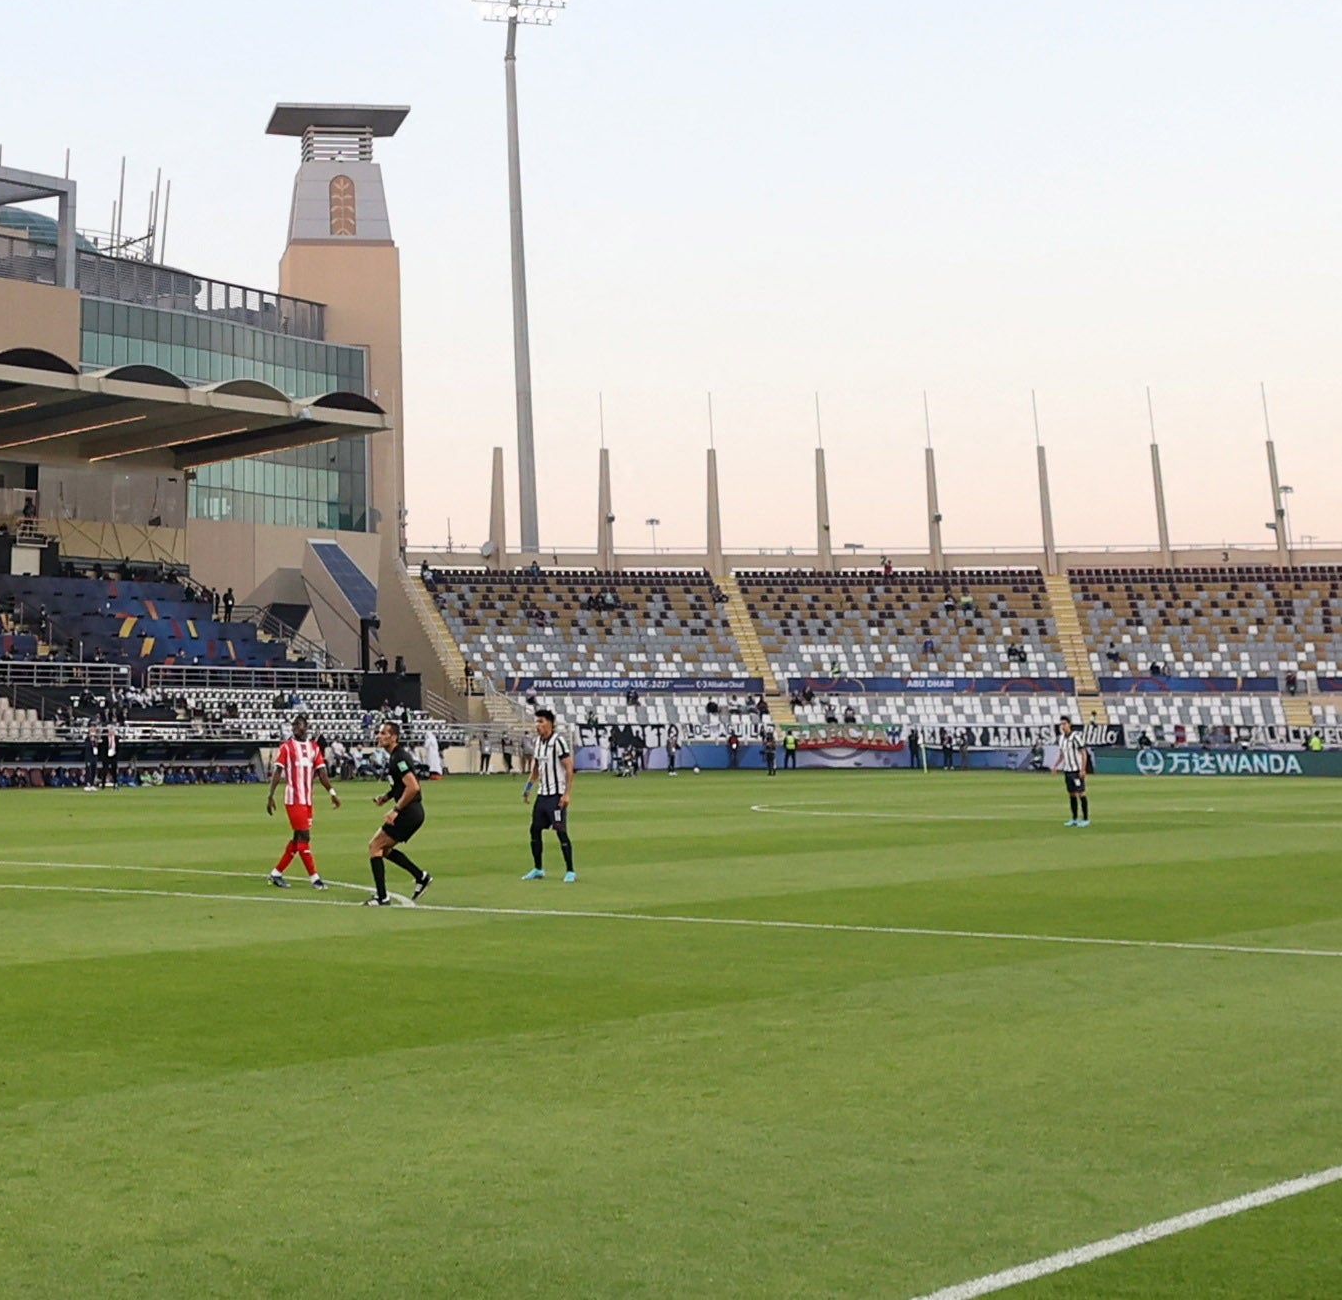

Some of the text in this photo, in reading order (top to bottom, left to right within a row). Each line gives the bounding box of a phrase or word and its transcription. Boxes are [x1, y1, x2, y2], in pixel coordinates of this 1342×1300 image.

[1222, 551, 1229, 562] 3
[533, 680, 553, 688] FIFA
[553, 680, 577, 688] CLUB
[578, 680, 610, 688] WORLD
[612, 680, 630, 688] CUP
[906, 679, 954, 688] ABU DHABI
[1169, 752, 1216, 774] 万达
[1217, 754, 1303, 774] WANDA
